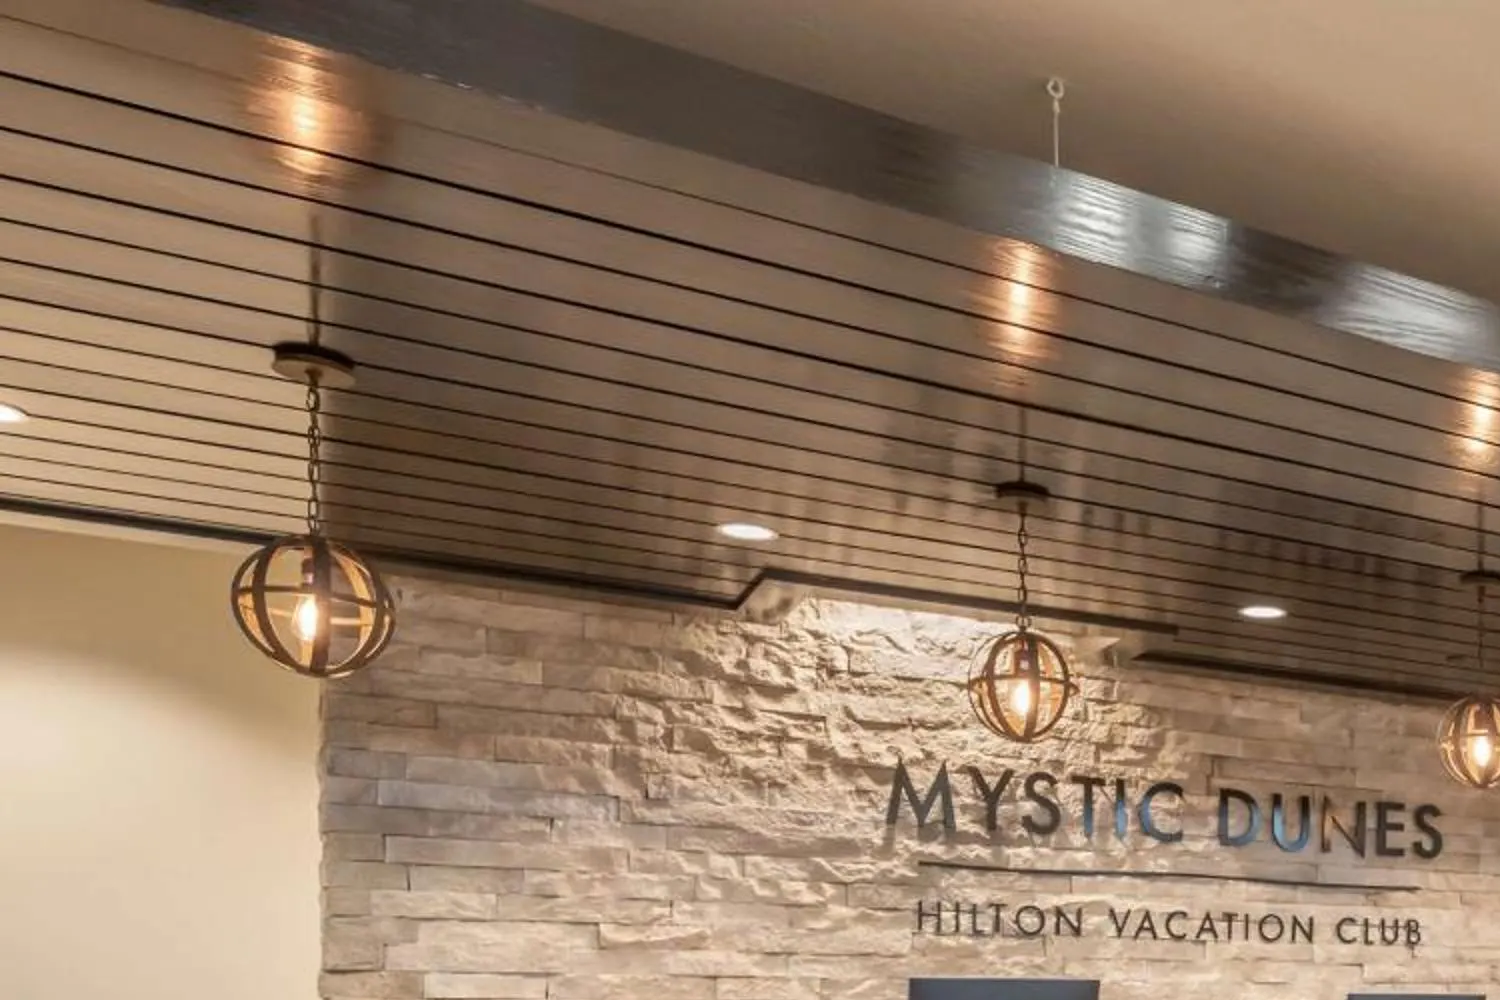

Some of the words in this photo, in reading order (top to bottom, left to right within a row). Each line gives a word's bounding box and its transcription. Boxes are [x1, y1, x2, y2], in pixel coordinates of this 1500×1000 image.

[886, 759, 1185, 843] MYSTIC
[1217, 787, 1443, 859] DUNES
[917, 900, 1083, 937] HILTON
[1109, 908, 1314, 944] VACATION
[1336, 917, 1422, 945] CLUB
